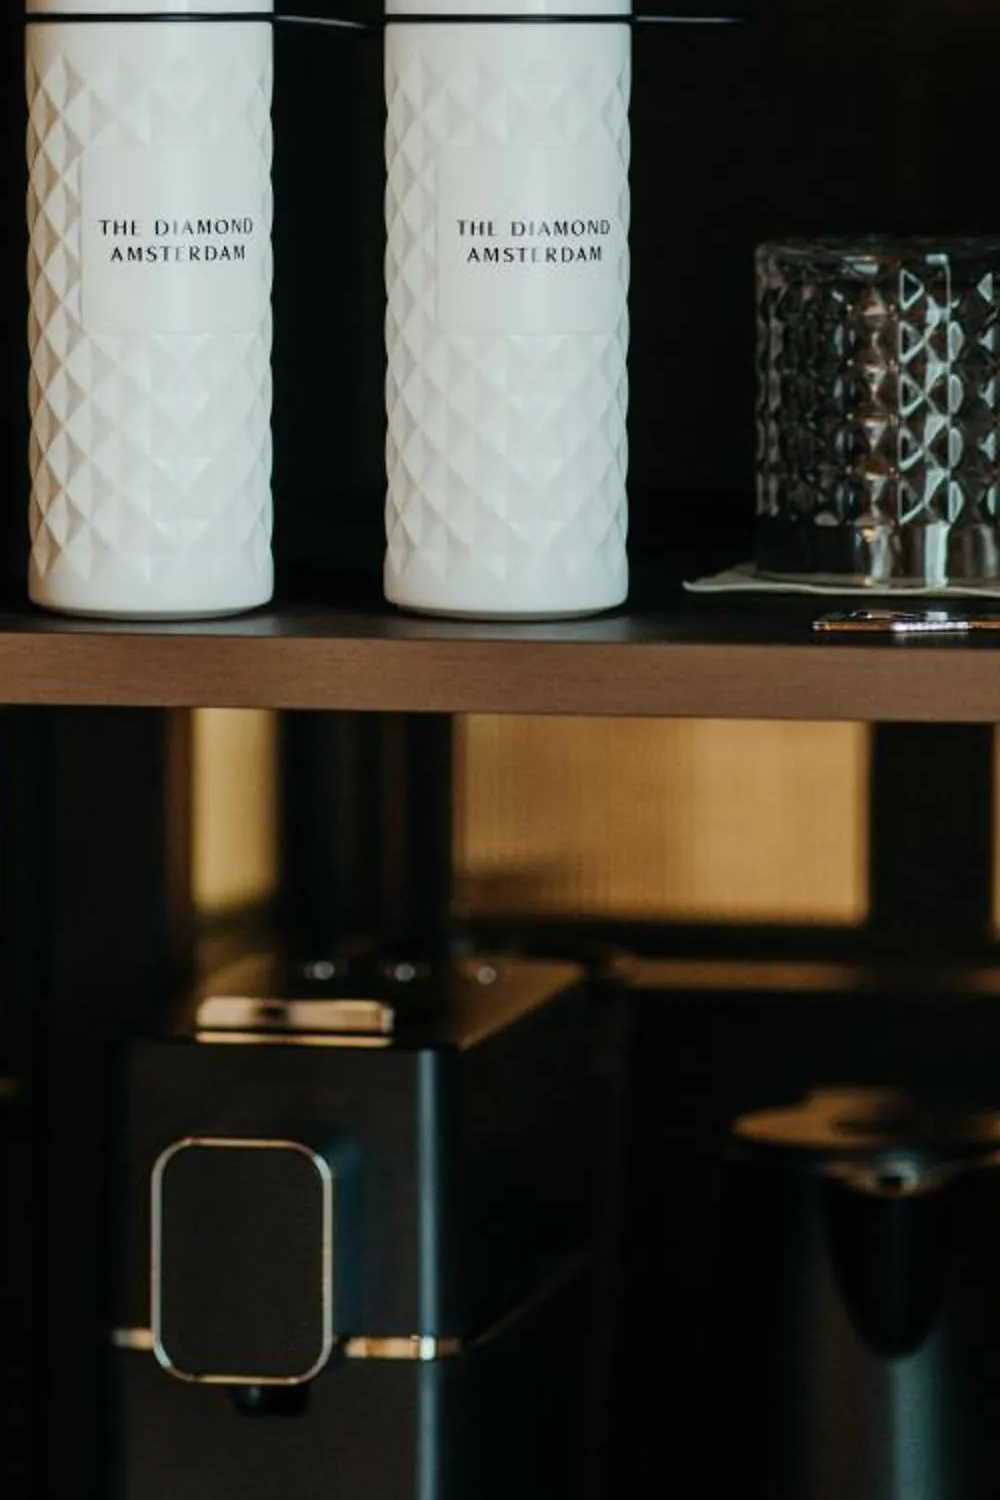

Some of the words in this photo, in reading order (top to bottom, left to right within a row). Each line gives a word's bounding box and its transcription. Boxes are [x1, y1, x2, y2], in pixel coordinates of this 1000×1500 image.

[98, 219, 141, 236] THE
[155, 218, 254, 236] DIAMOND
[457, 219, 497, 236] THE
[511, 219, 610, 237] DIAMOND
[110, 245, 245, 262] AMSTERDAM
[467, 246, 602, 263] AMSTERDAM
